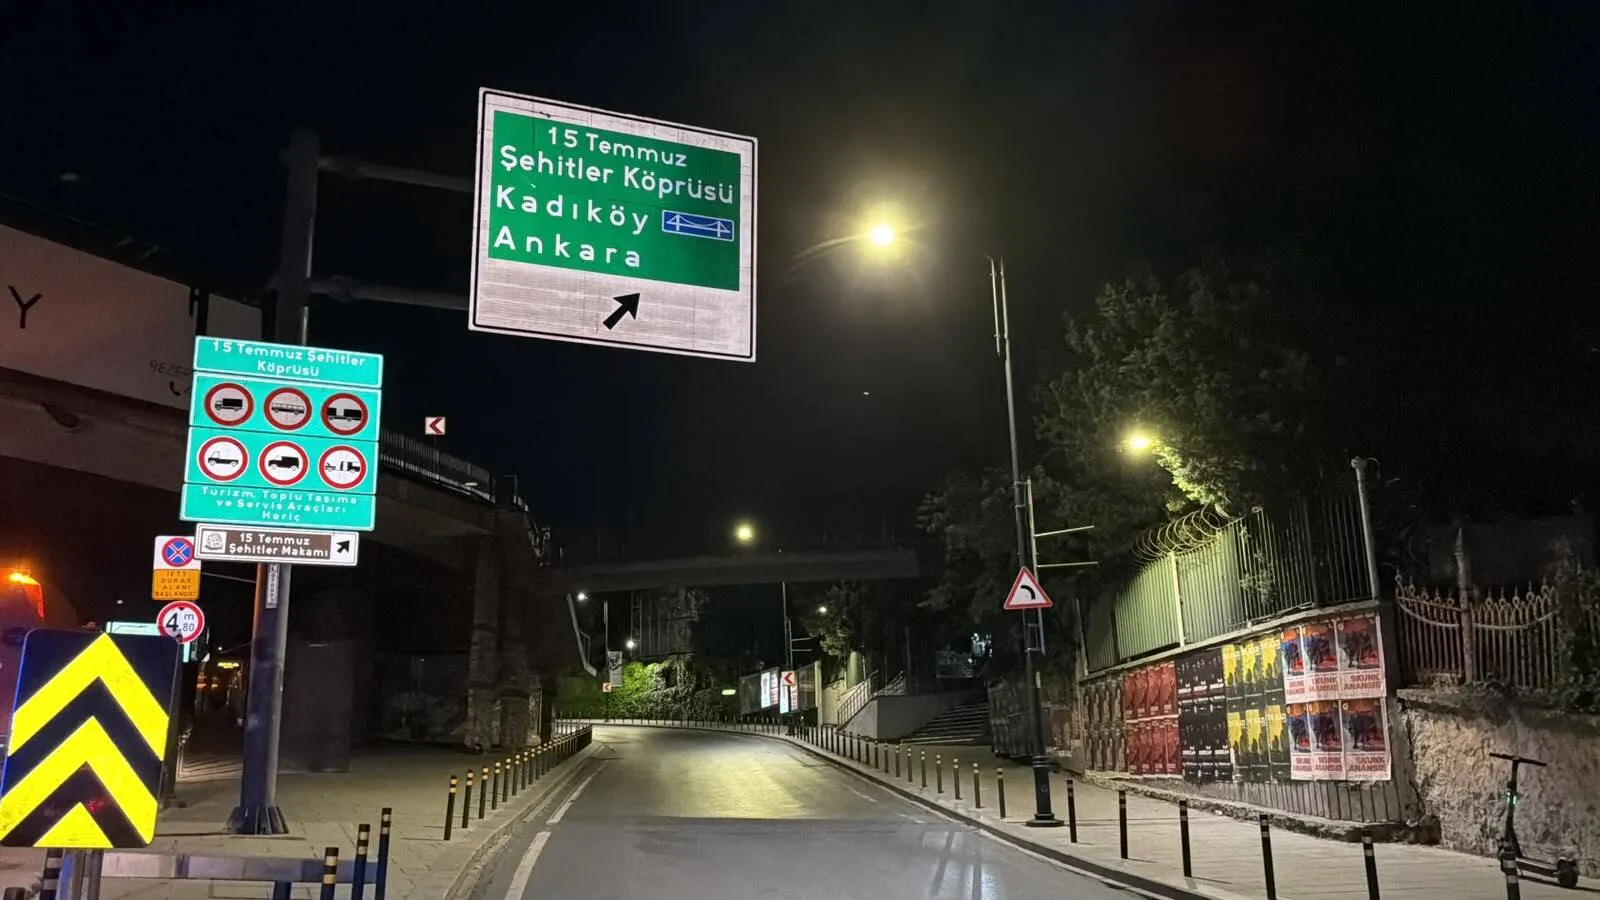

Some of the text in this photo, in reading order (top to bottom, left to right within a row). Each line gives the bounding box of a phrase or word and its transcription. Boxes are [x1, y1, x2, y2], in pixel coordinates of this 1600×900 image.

[548, 126, 687, 168] 15 Temmuz
[500, 145, 734, 205] Şehitler Köprüsü
[496, 184, 649, 235] Kadıköy
[494, 225, 641, 268] Ankara
[213, 340, 366, 367] 15 Temmuz Şehitler
[256, 359, 320, 377] Köprüsü
[216, 498, 347, 513] ve Servis Araçları
[262, 489, 302, 501] Toplu
[307, 492, 358, 505] Taşıma
[262, 511, 301, 522] Hariç
[239, 533, 311, 547] 15 Temmuz
[228, 543, 329, 557] Şehitler Makamı
[165, 612, 179, 632] 4
